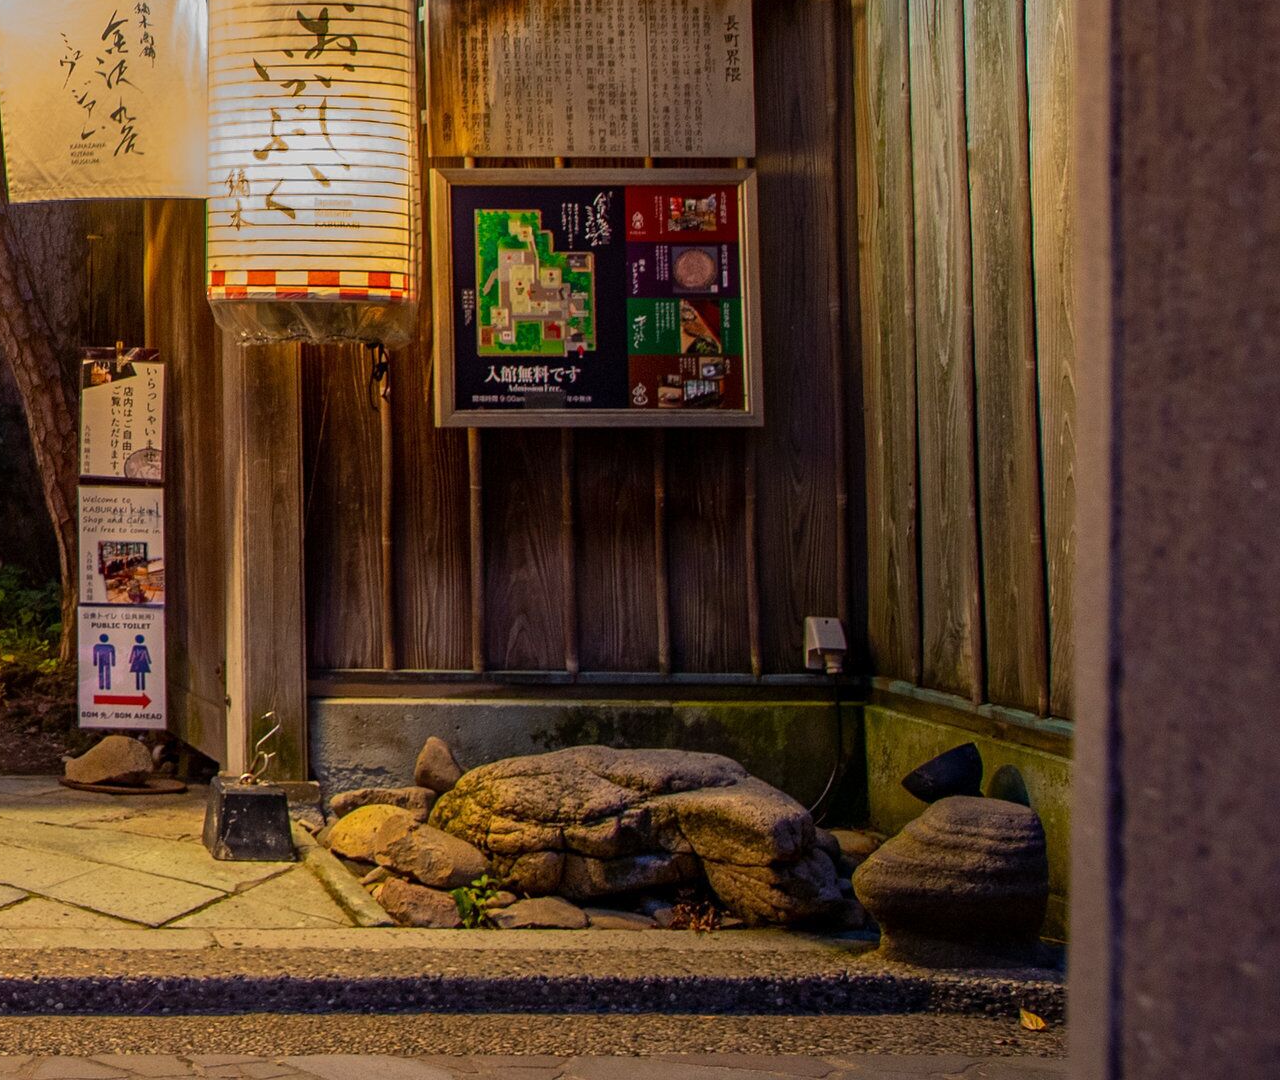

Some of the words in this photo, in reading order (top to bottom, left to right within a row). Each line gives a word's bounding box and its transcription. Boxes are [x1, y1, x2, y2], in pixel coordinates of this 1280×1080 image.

[724, 15, 742, 83] 長町界隈
[224, 167, 254, 231] 鏑木
[484, 365, 581, 383] 入館無料です
[110, 385, 122, 476] ご覧いただけます。
[122, 386, 134, 461] 店内はご自由に
[143, 367, 158, 463] いらっしゃいませ
[82, 506, 127, 514] KABURAKI
[82, 516, 104, 525] Shop
[123, 622, 151, 630] TOILET
